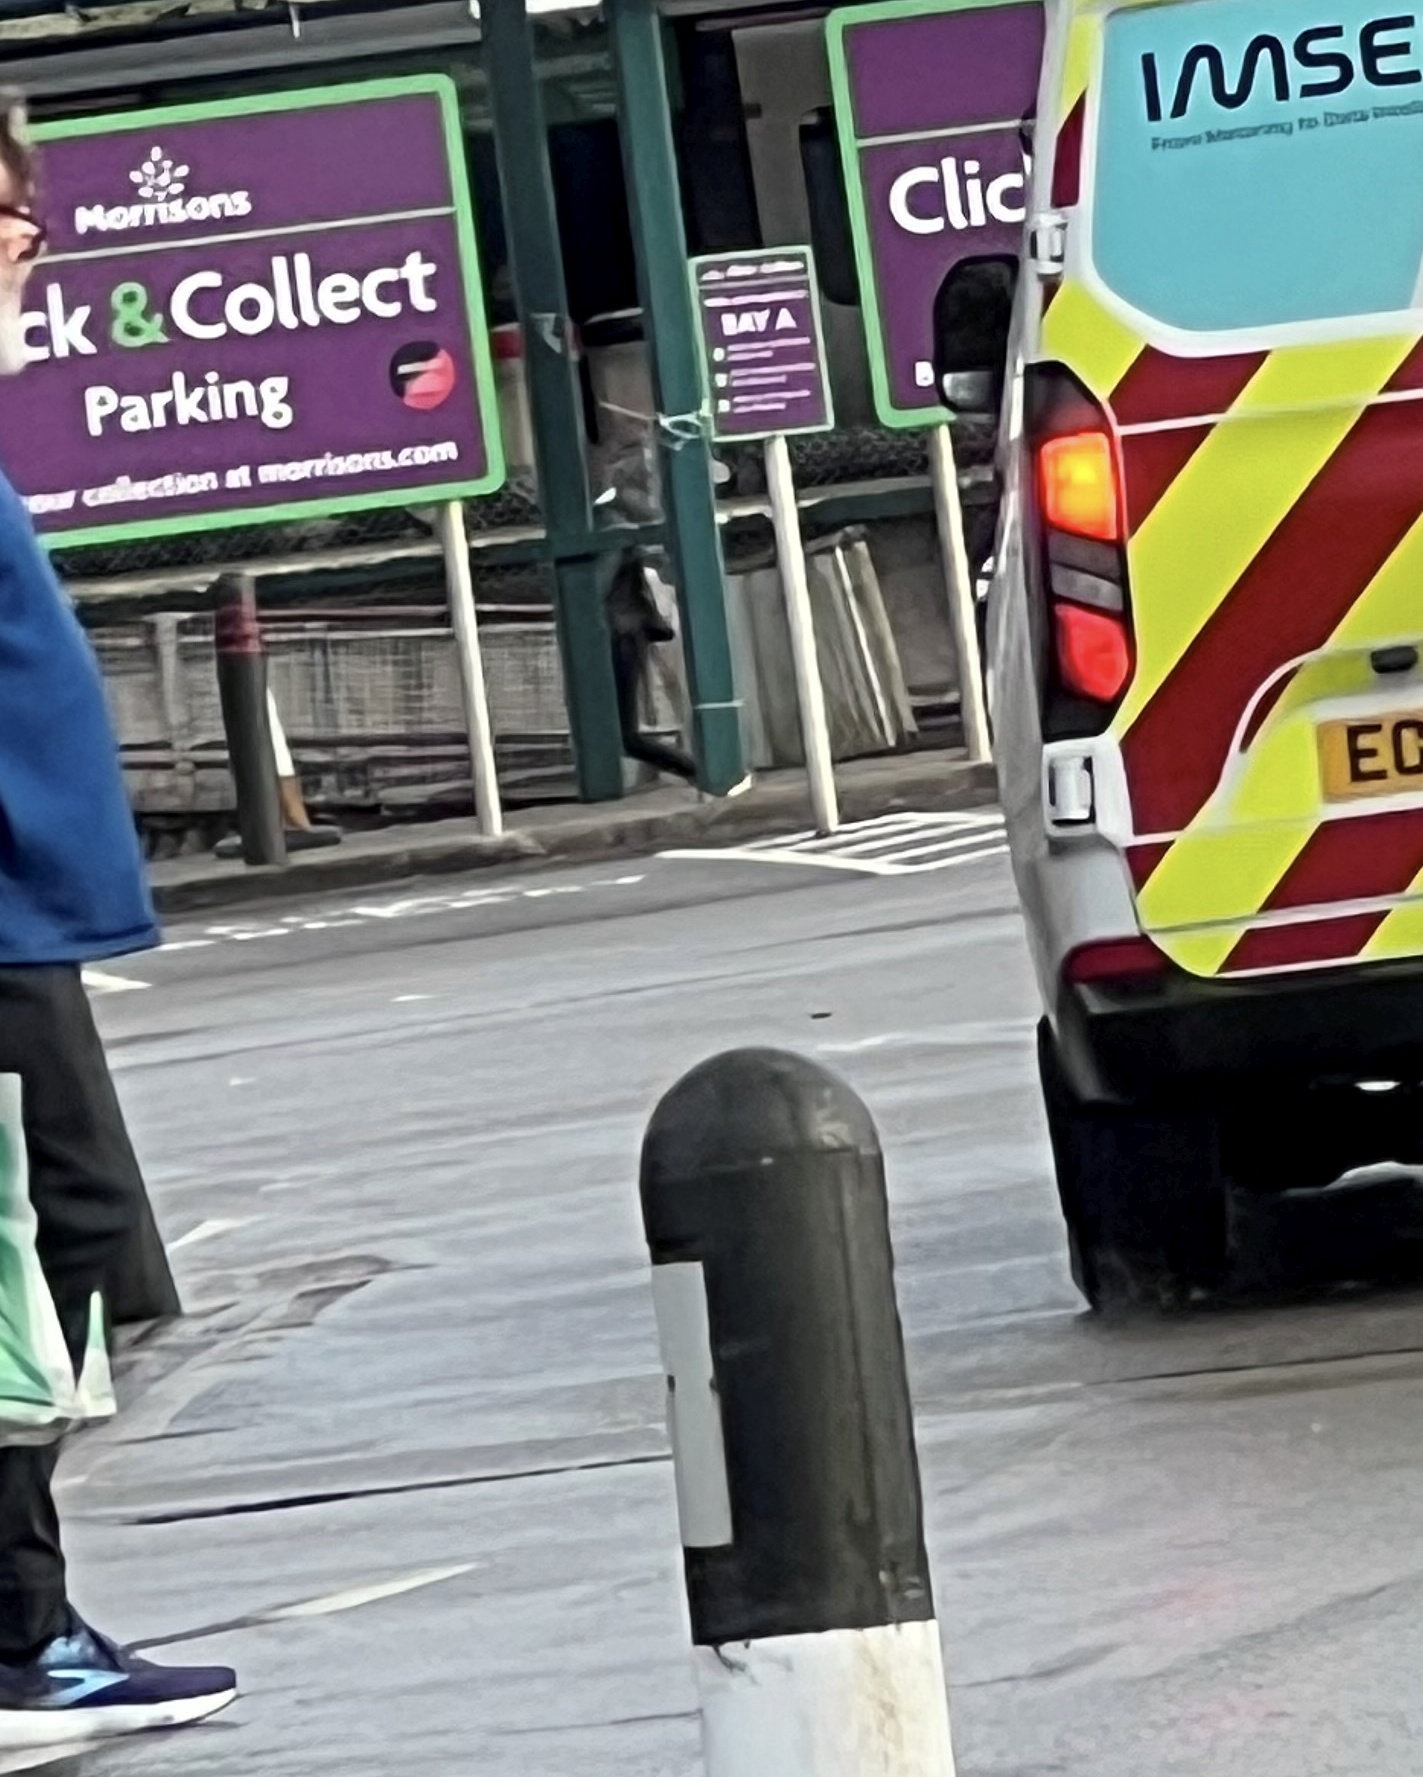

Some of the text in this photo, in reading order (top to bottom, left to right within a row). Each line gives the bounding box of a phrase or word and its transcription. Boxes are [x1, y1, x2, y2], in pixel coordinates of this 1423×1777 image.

[1141, 15, 1423, 122] IMSE
[75, 190, 253, 235] Morrisons
[888, 155, 1033, 235] Clic
[19, 251, 438, 363] ck & Collect
[775, 307, 797, 331] A
[83, 371, 294, 437] Parking
[22, 489, 76, 514] our
[257, 441, 459, 484] morrisons.com
